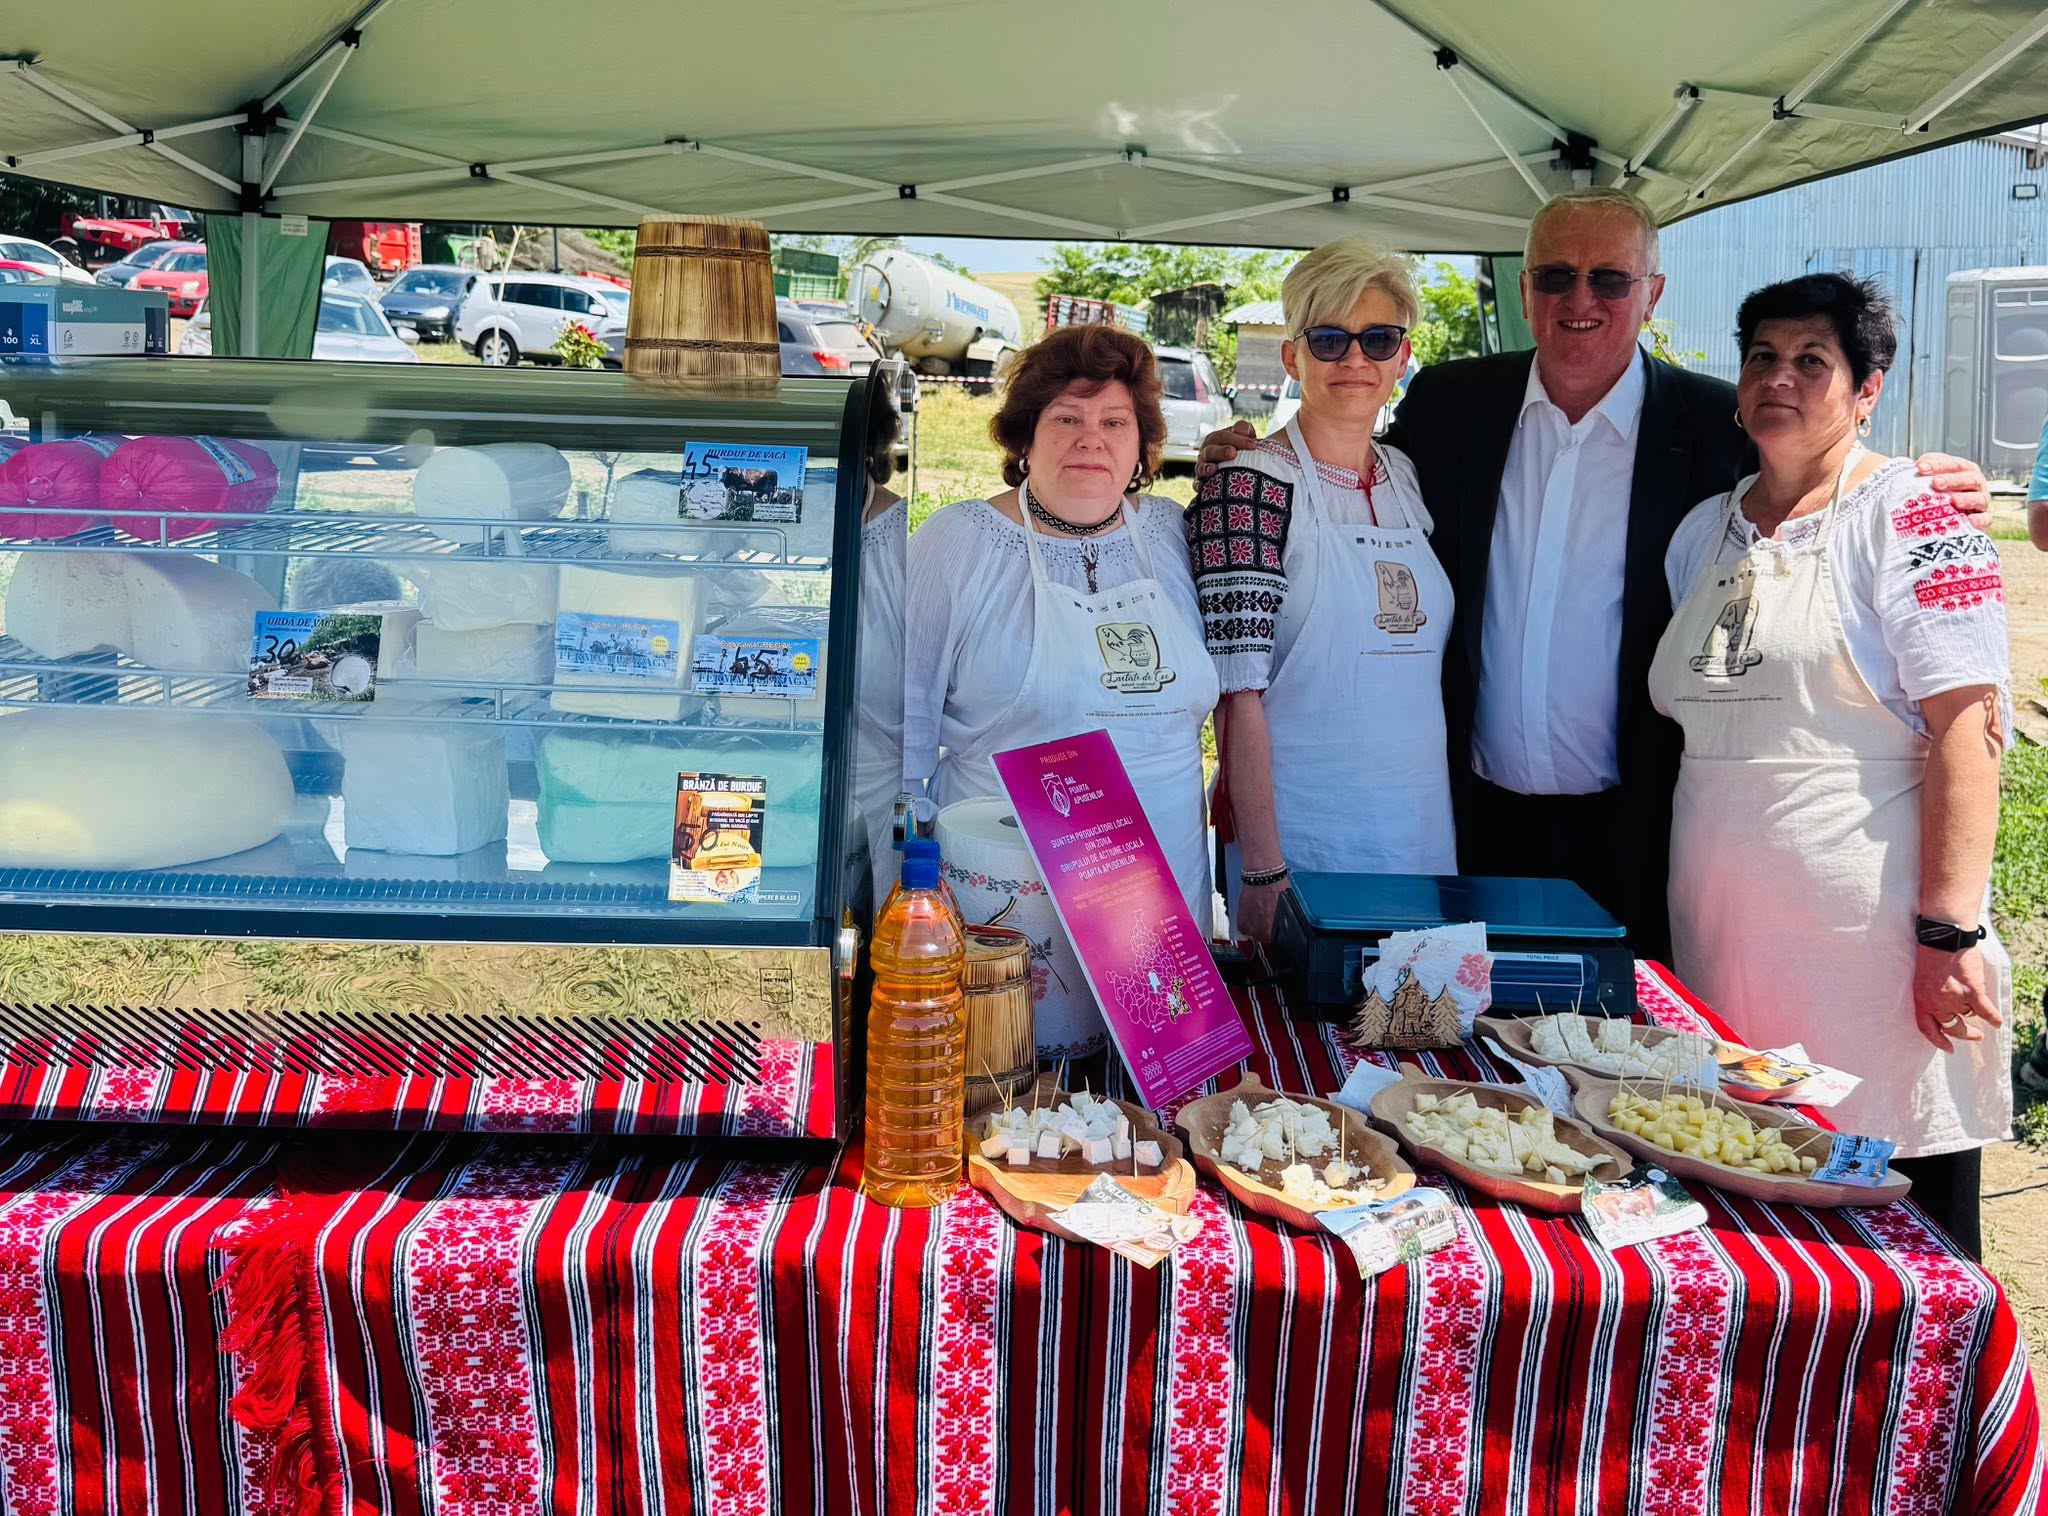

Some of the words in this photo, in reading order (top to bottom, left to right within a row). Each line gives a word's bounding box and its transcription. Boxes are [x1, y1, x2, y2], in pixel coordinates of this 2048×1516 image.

[3, 336, 19, 344] 100
[748, 450, 763, 459] DE
[296, 618, 312, 627] DE
[260, 635, 296, 664] 30
[1141, 671, 1152, 682] de
[1040, 752, 1068, 765] PRODUSE
[1067, 750, 1079, 759] DIN
[682, 777, 716, 791] BRÂNZĂ
[718, 781, 729, 791] DE
[730, 780, 763, 792] BURDUF
[1064, 776, 1077, 786] GAL
[1069, 783, 1090, 795] POARTA
[1073, 789, 1105, 805] APUSENILOR
[1050, 834, 1077, 849] SUNTEM
[1075, 824, 1115, 843] PRODUCĂTORI
[1113, 815, 1134, 830] LOCALI
[1084, 841, 1097, 852] DIN
[1097, 835, 1113, 849] ZONA
[1060, 857, 1091, 873] GRUPULUI
[1089, 853, 1100, 863] DE
[1122, 836, 1145, 853] LOCALĂ
[1078, 866, 1102, 881] POARTA
[780, 893, 797, 901] GLASS
[1095, 1189, 1111, 1203] DE
